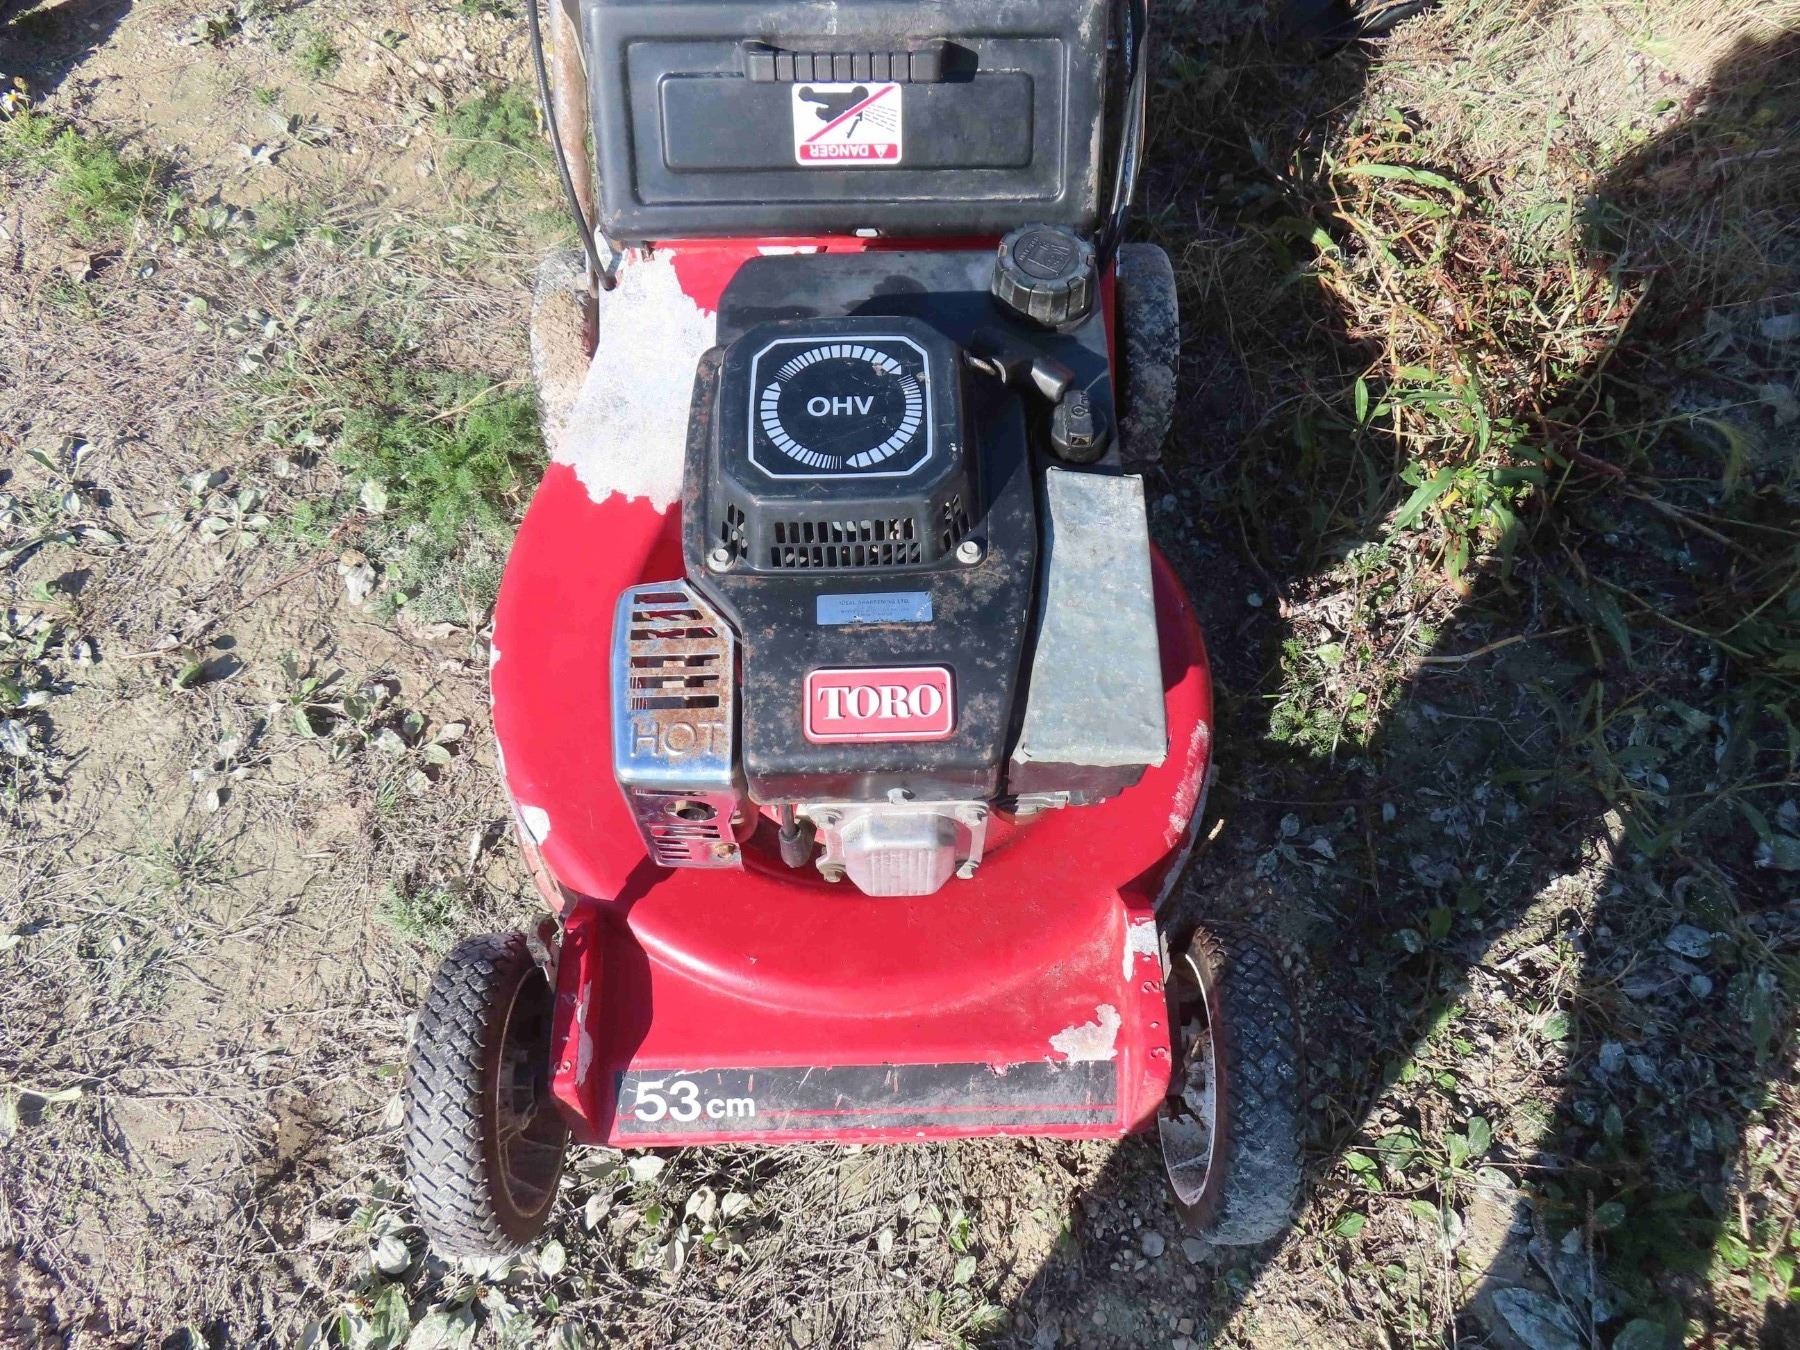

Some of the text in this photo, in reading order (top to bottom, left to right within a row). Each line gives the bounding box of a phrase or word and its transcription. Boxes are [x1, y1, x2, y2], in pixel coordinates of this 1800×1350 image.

[810, 144, 869, 157] DANGER
[806, 395, 875, 417] OHV
[817, 683, 943, 720] TORO
[630, 719, 725, 757] HOT
[634, 1080, 756, 1122] 53 cm
